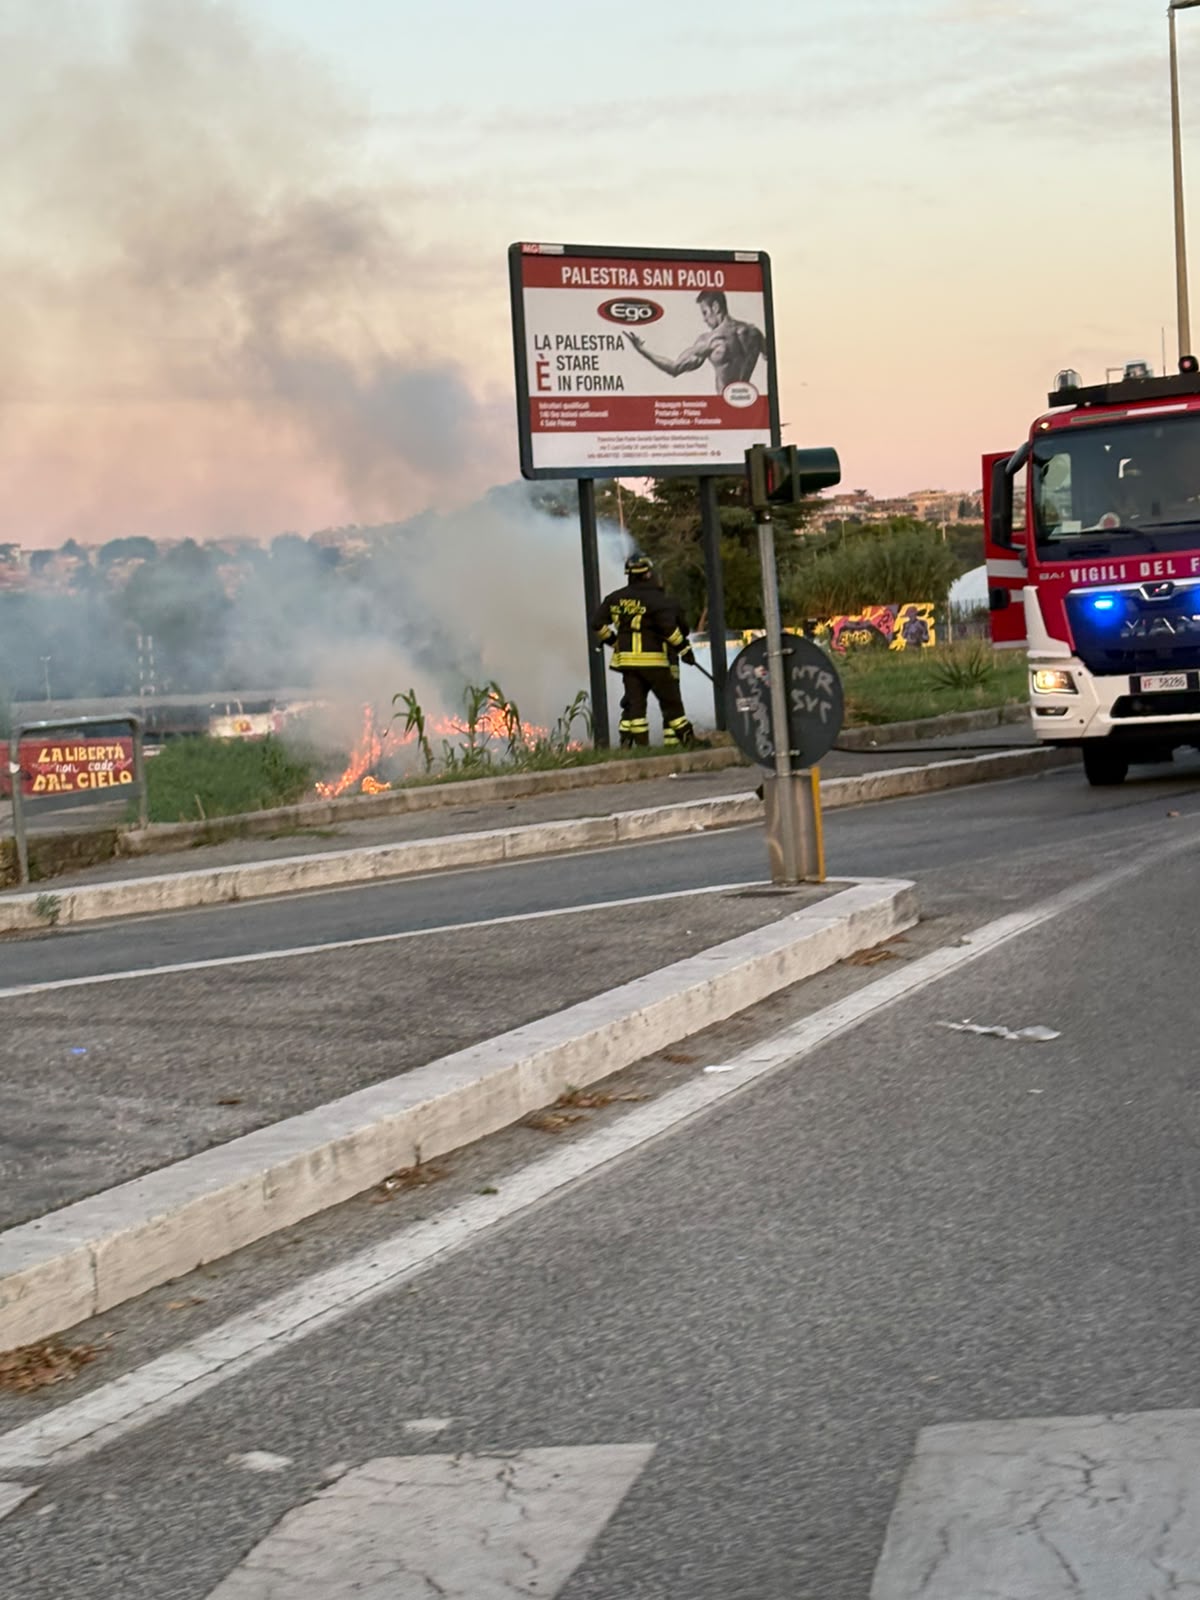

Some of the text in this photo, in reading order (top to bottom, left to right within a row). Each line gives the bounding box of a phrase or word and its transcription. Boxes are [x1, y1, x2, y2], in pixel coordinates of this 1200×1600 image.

[561, 267, 725, 288] PALESTRA SAN PAOLO
[610, 303, 652, 321] Ego
[534, 334, 625, 351] LA PALESTRA
[536, 353, 599, 391] È STARE
[558, 375, 625, 391] IN FORMA
[1070, 564, 1126, 583] VIGILI
[1139, 560, 1176, 577] DEL
[38, 742, 125, 763] LA LIBERTÀ
[32, 770, 133, 792] DAL CIELO
